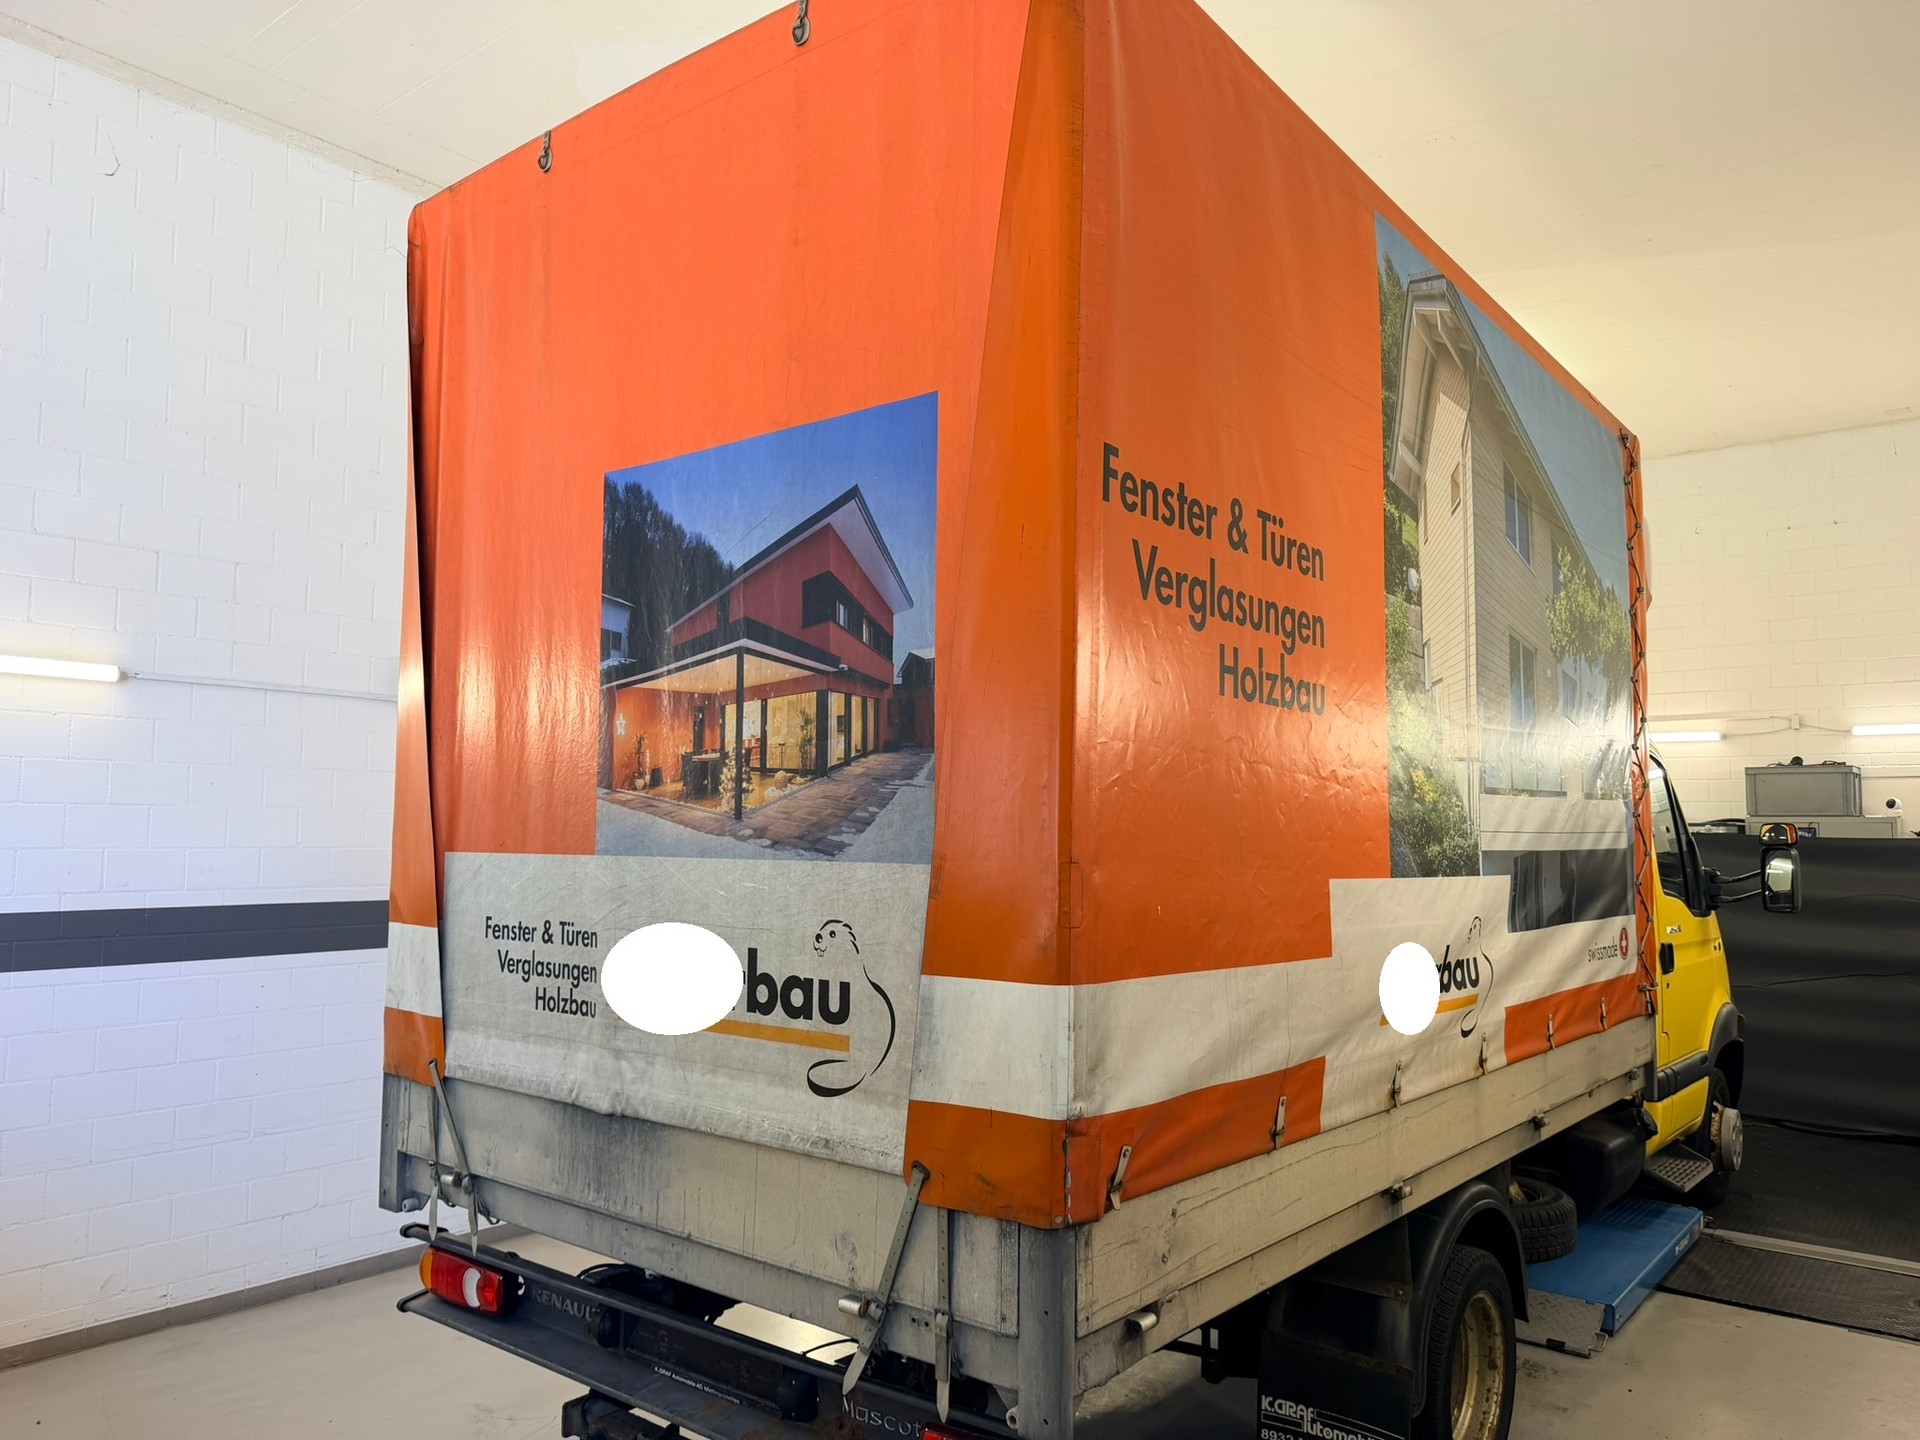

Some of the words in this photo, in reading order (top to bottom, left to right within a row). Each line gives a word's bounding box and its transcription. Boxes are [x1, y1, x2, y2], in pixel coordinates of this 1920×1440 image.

[1102, 441, 1218, 540] Fenster
[1227, 497, 1249, 554] &
[1257, 508, 1324, 581] Türen
[1131, 538, 1325, 656] Verglasungen
[1219, 643, 1326, 716] Holzbau
[485, 916, 537, 943] Fenster
[541, 920, 554, 944] &
[559, 921, 598, 949] Türen
[1588, 936, 1618, 963] swissmode
[497, 949, 598, 987] Verglasungen
[535, 986, 597, 1019] Holzbau
[530, 1286, 600, 1322] RENAUL
[842, 1396, 922, 1438] Mascot
